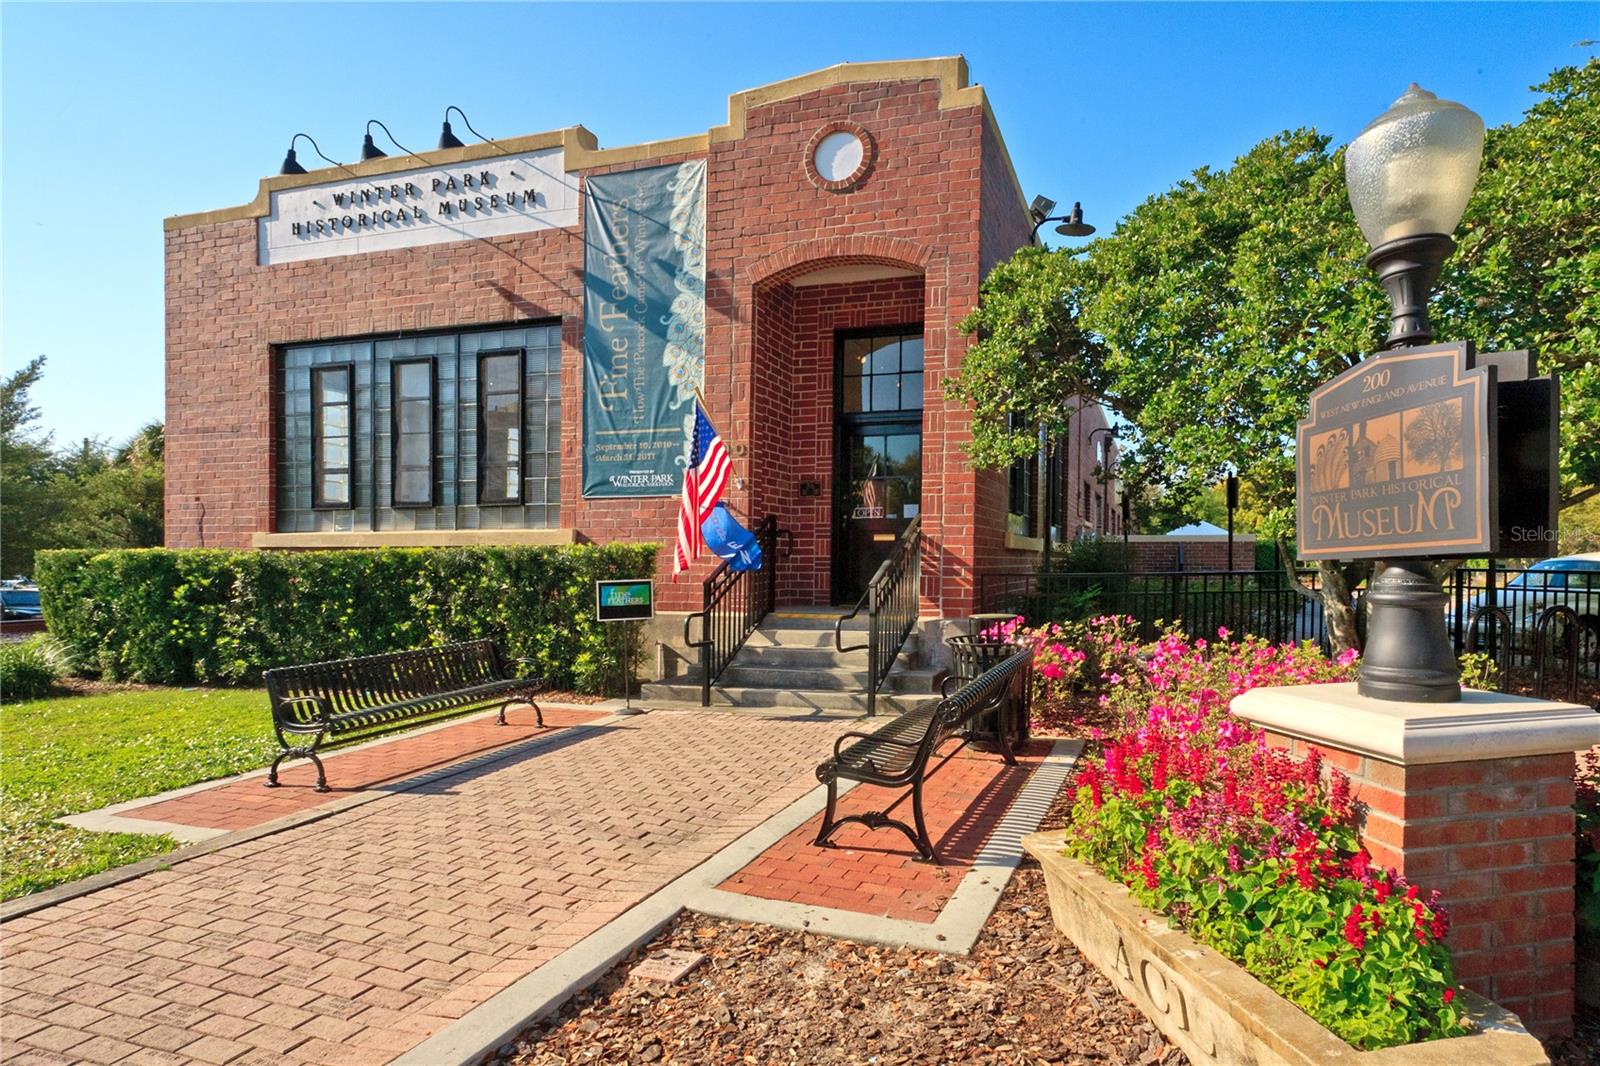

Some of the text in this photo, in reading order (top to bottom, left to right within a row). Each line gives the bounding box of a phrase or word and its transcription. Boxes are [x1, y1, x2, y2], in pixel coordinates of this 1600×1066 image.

[332, 171, 491, 206] WINTER PARK
[291, 188, 537, 236] HISTORICAL MUSEUM
[634, 213, 647, 258] Winter
[599, 198, 630, 412] Fine Feathers
[634, 281, 648, 314] Came
[633, 316, 646, 363] Peacock
[633, 363, 646, 393] The
[1362, 368, 1391, 393] 200
[633, 394, 646, 424] How
[1320, 374, 1448, 418] WEST NEW ENGLAND AVENUE
[595, 442, 638, 453] September
[595, 453, 622, 462] March
[609, 475, 649, 487] WINTER
[651, 473, 674, 483] PARK
[1310, 474, 1464, 505] WINTER PARK HISTORICAL
[1311, 486, 1462, 541] MUSEUM
